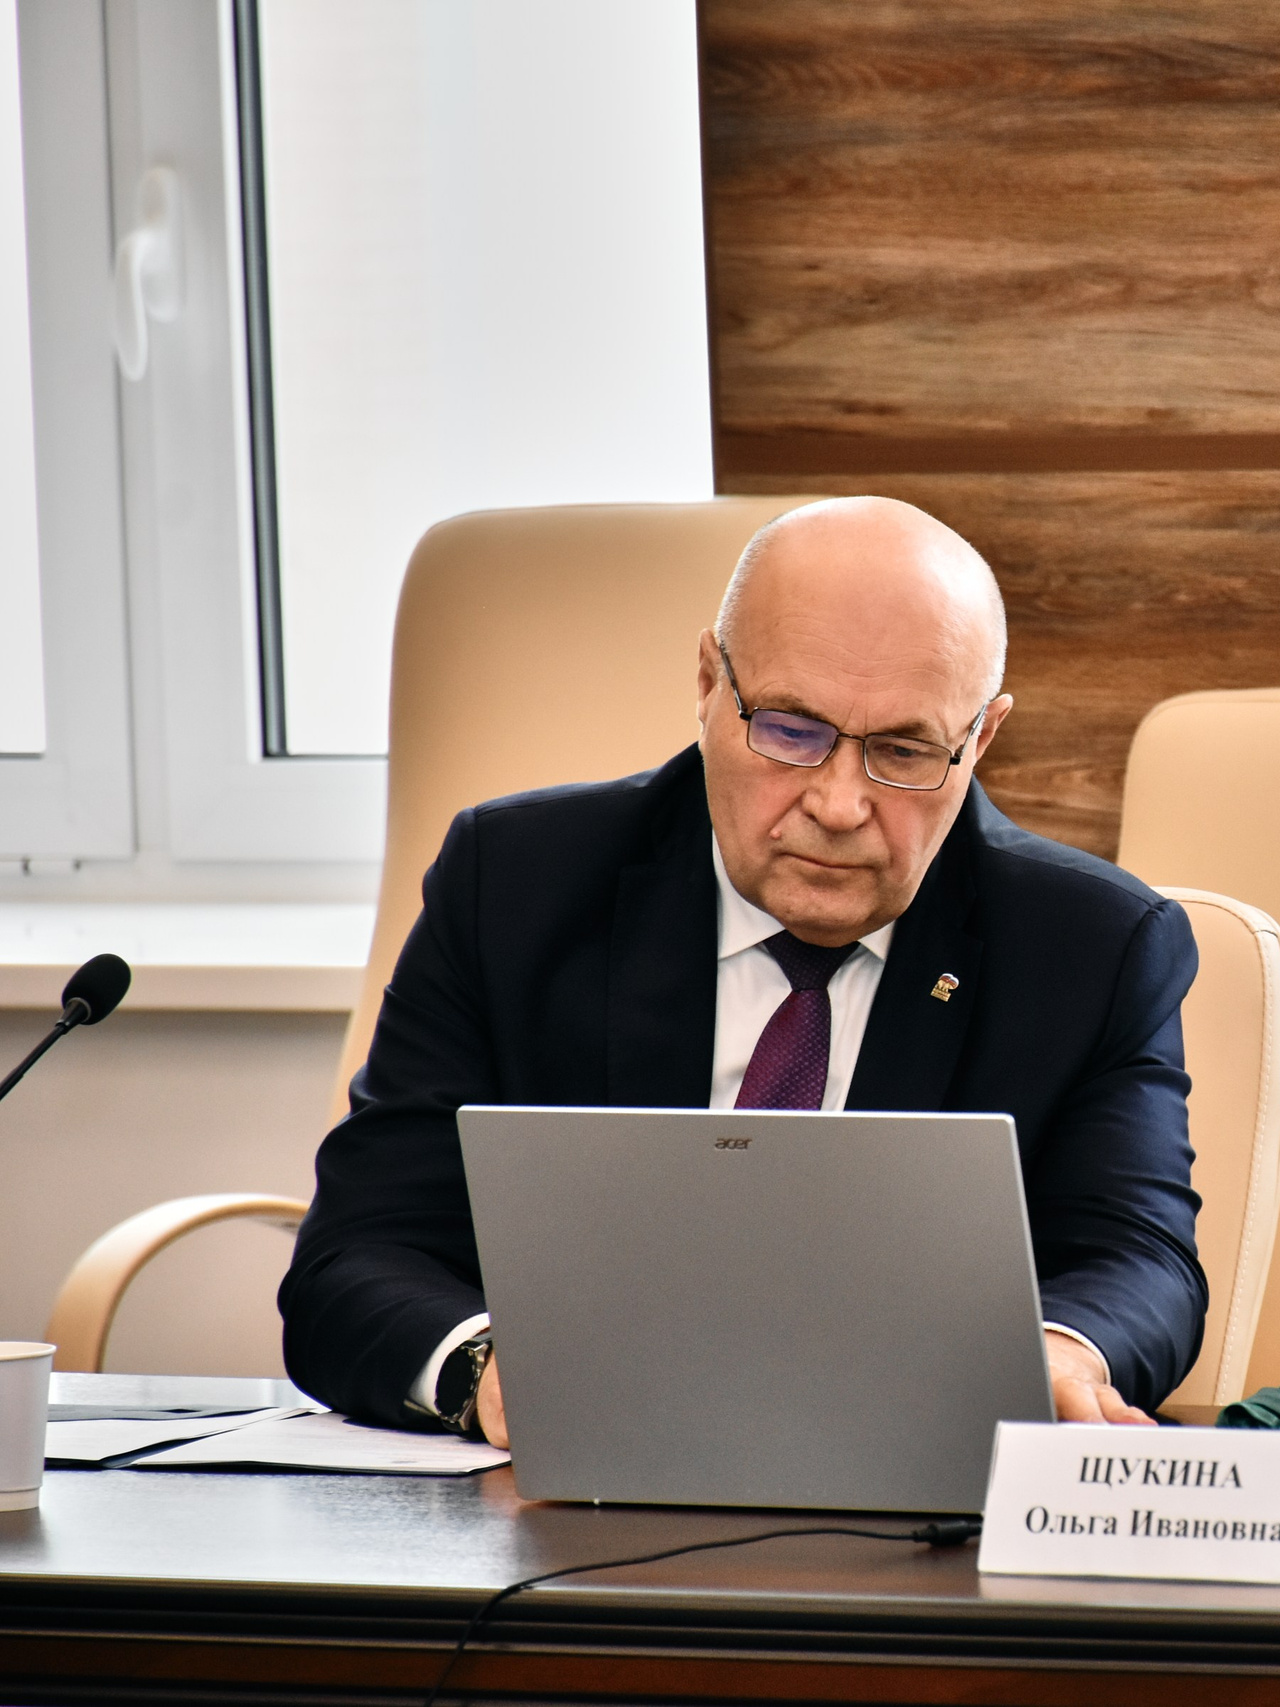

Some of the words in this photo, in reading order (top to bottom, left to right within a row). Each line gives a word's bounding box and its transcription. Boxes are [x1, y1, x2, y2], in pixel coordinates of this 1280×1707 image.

[714, 1137, 753, 1150] acer
[1079, 1456, 1243, 1489] ЩУКИНА
[1025, 1506, 1118, 1536] Ольга
